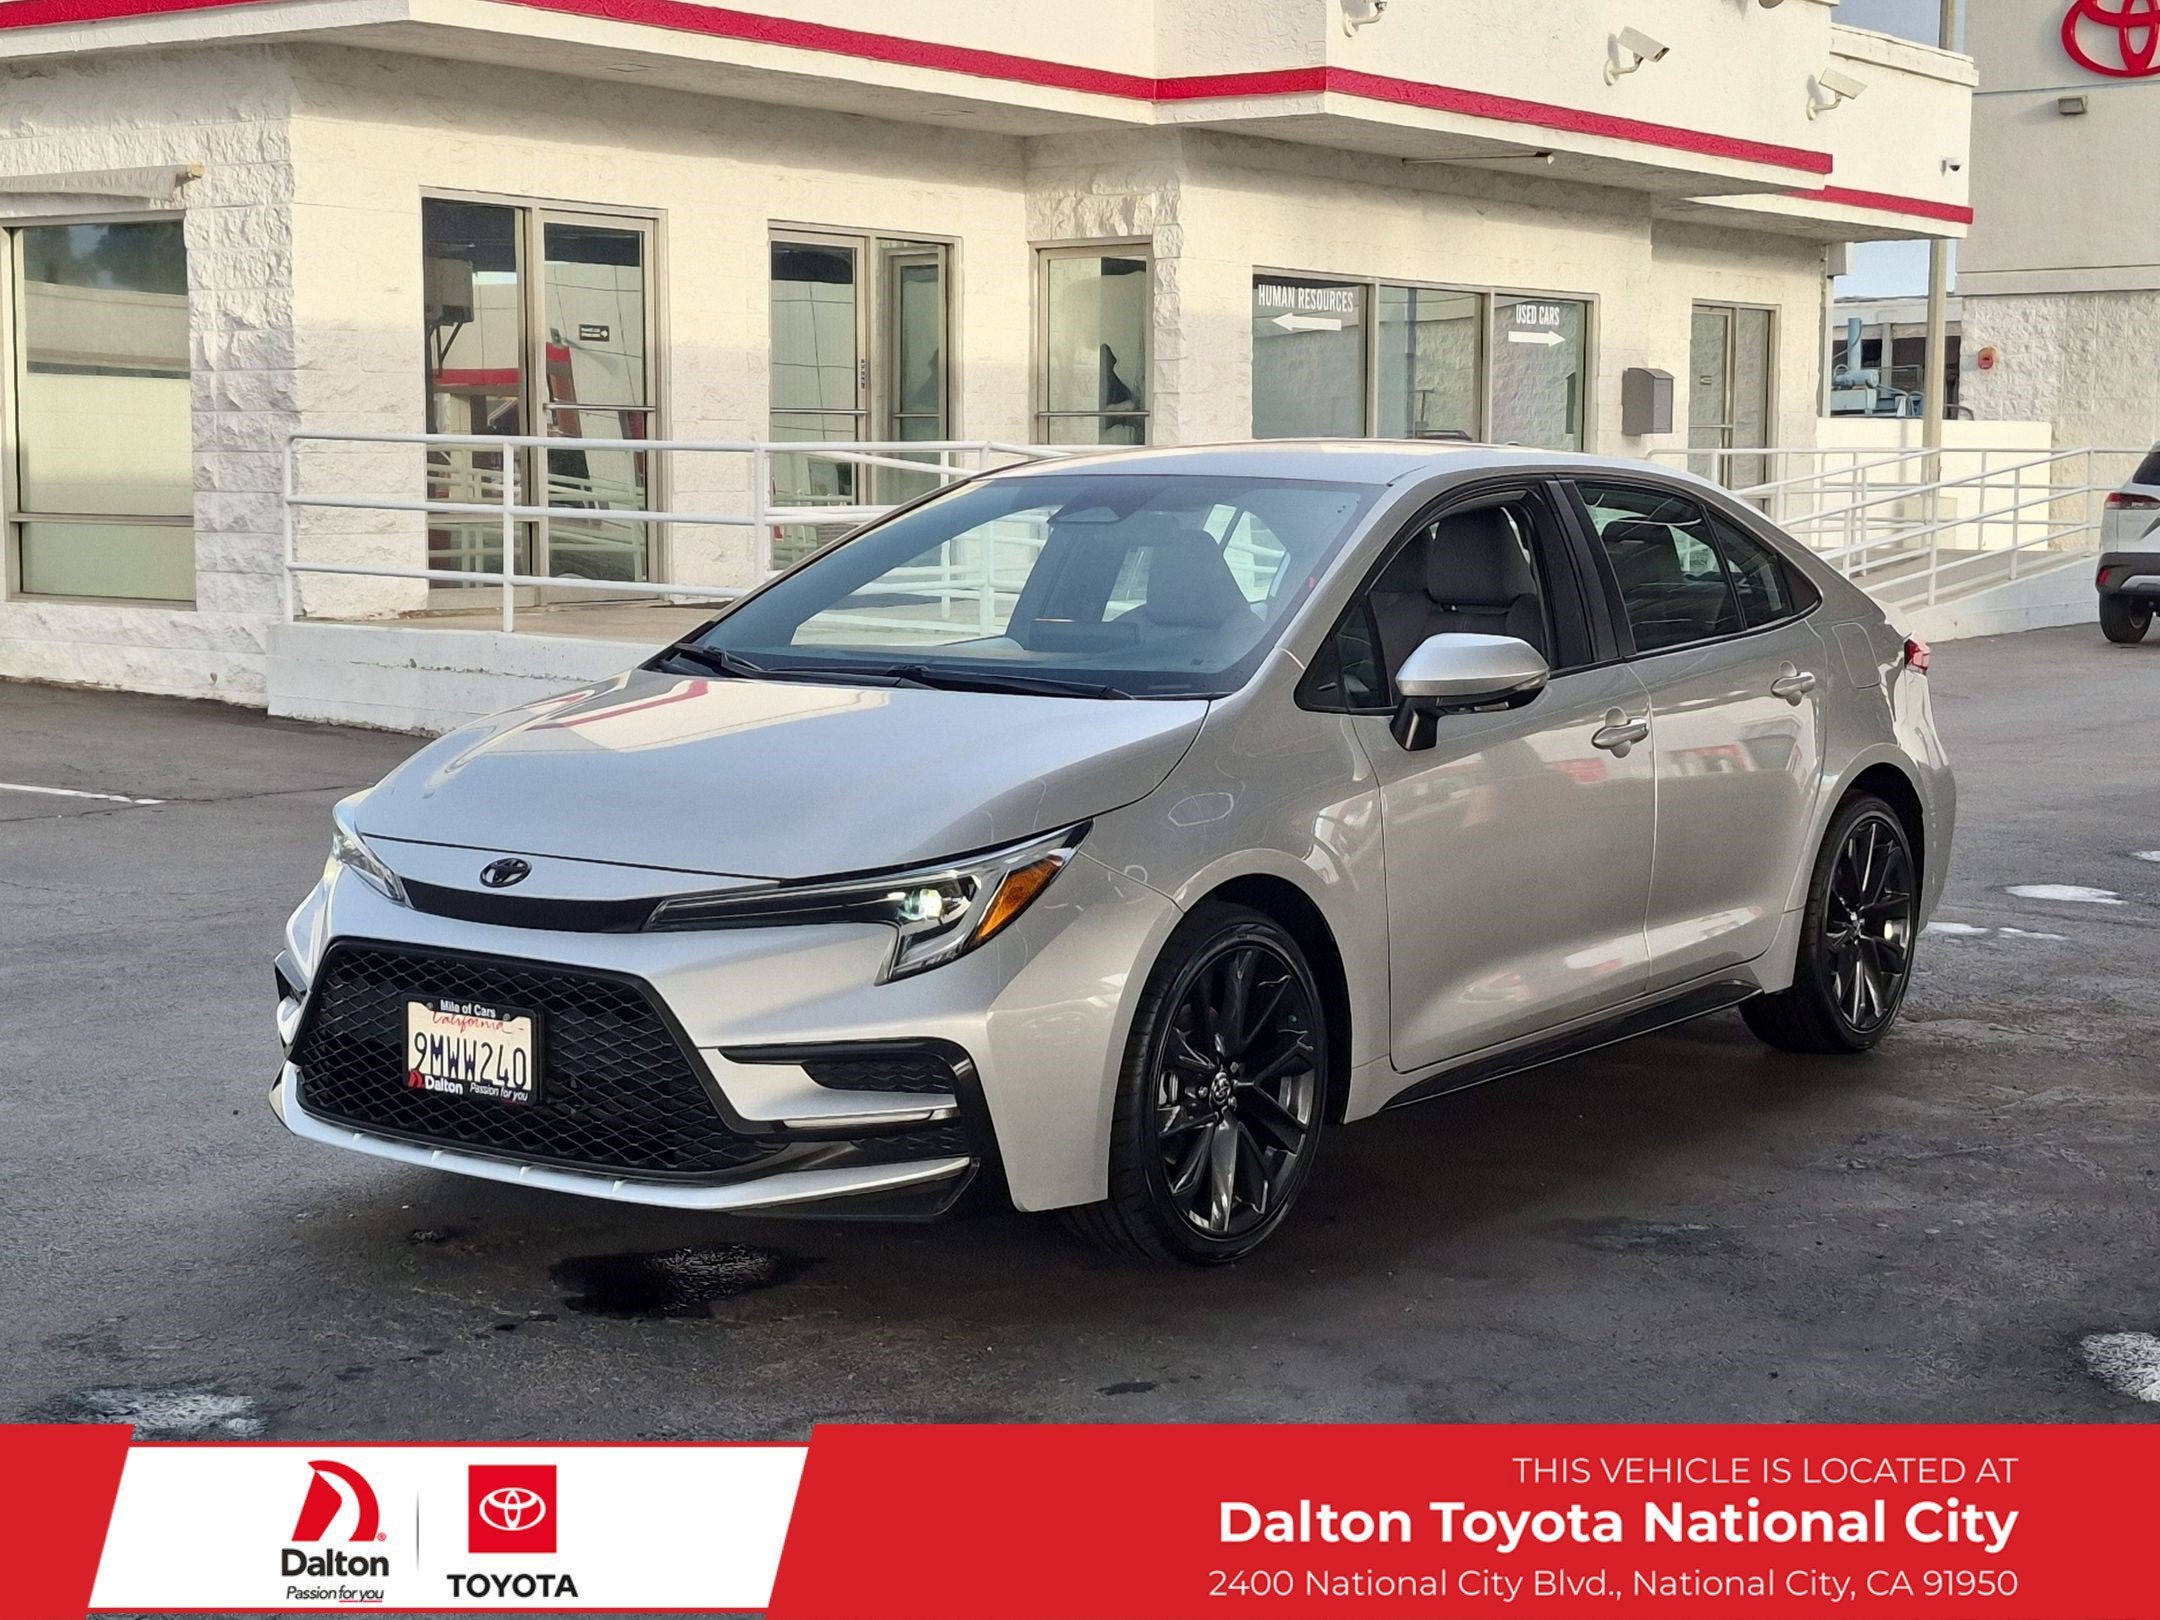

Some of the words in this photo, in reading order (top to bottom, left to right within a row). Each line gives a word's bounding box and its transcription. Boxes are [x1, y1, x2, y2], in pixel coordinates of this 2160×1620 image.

[1258, 284, 1295, 308] HUMAN
[1298, 287, 1354, 312] RESOURCES
[1516, 304, 1537, 324] USED
[1539, 305, 1560, 325] CARS
[440, 1000, 460, 1013] Mile
[462, 1003, 472, 1014] of
[474, 1004, 497, 1018] Cars
[414, 1031, 527, 1089] 9MWW240
[424, 1074, 464, 1095] Dalton
[469, 1082, 499, 1097] Passion
[500, 1087, 513, 1098] for
[512, 1091, 529, 1102] you
